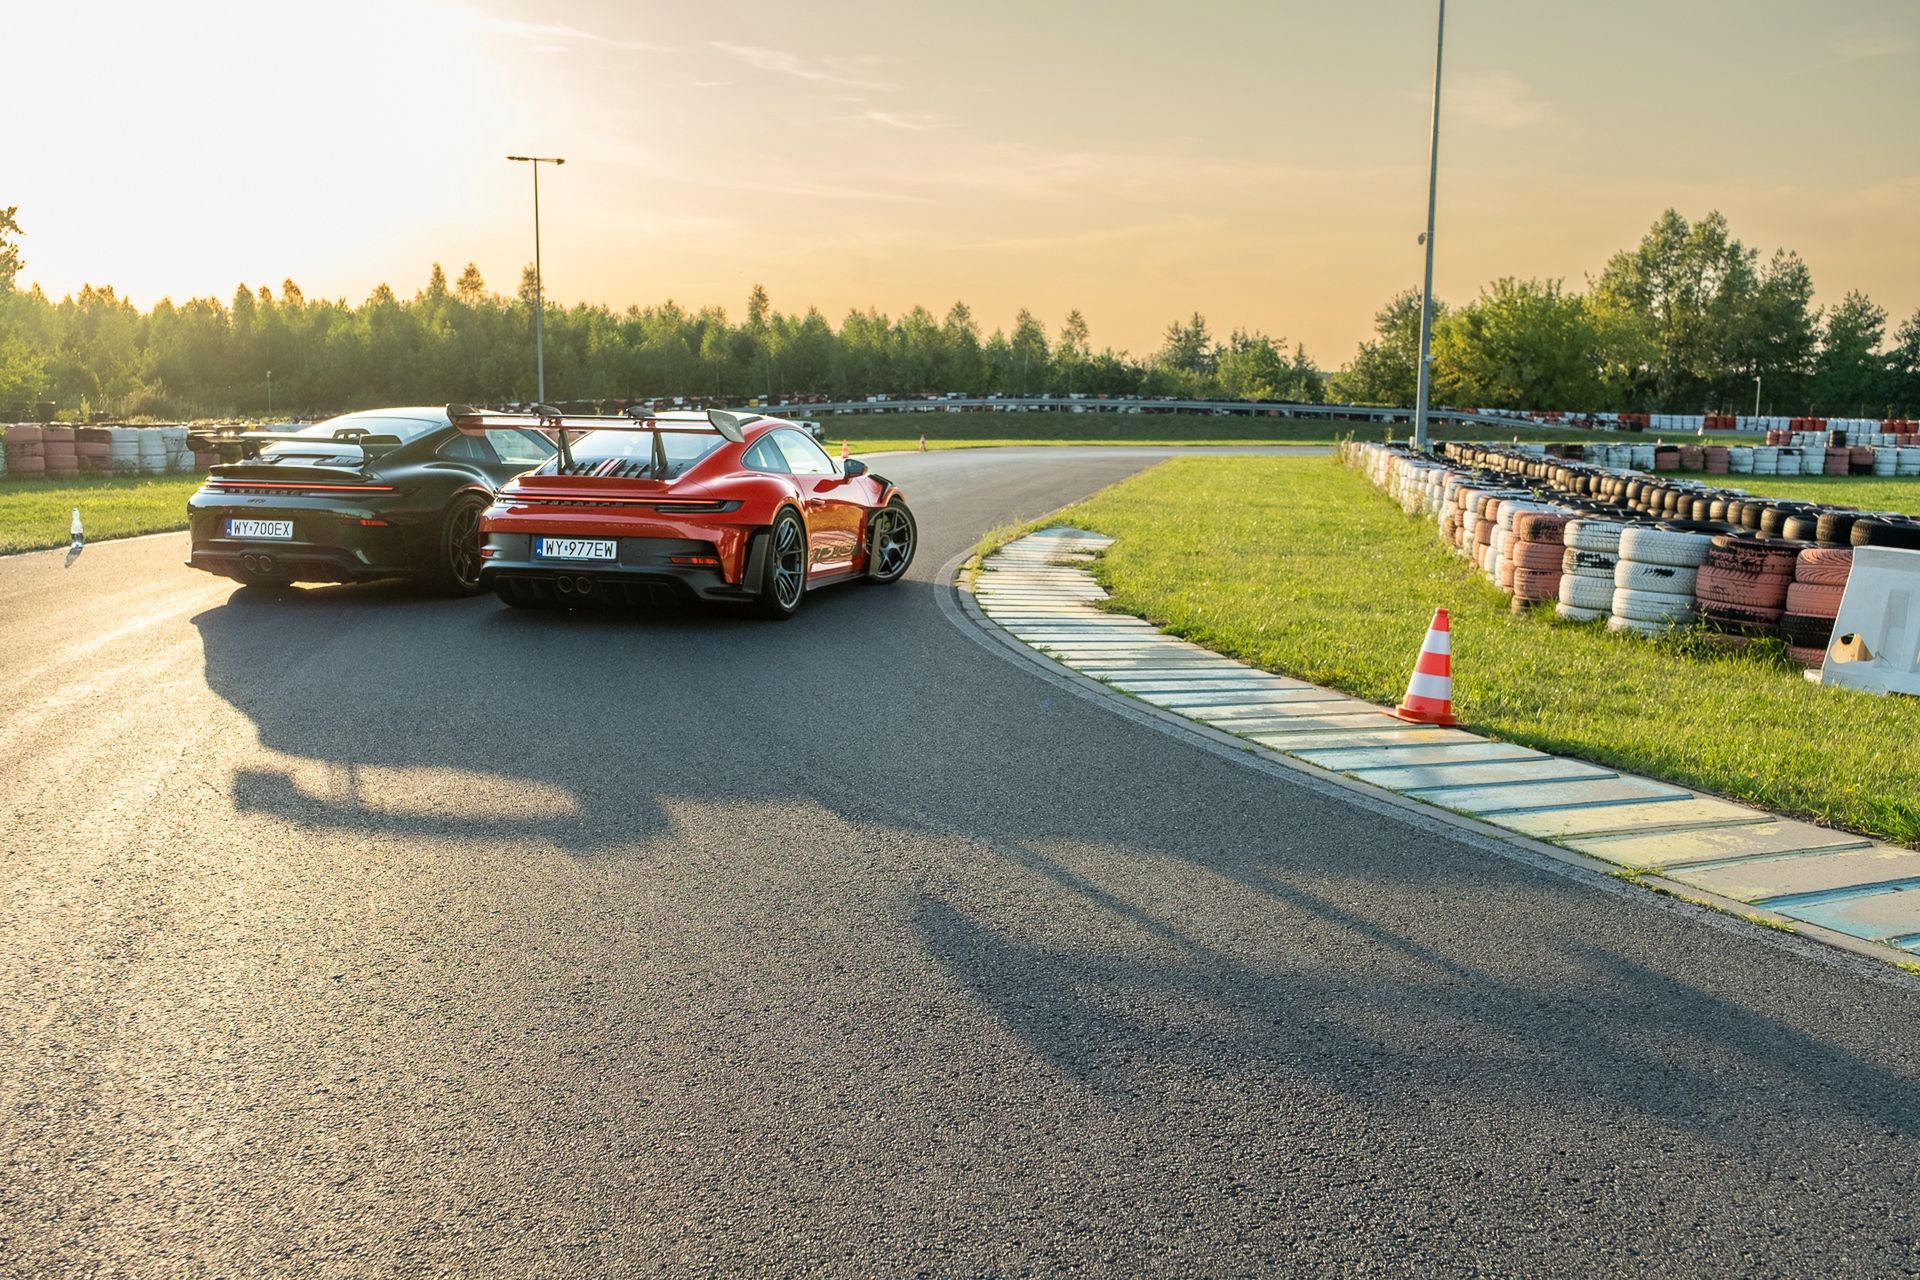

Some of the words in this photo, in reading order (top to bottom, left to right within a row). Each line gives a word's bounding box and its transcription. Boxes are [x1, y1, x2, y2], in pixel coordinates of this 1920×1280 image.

[234, 521, 249, 535] WY
[253, 521, 290, 536] 700EX
[545, 540, 564, 556] WY
[568, 541, 614, 558] 977EW
